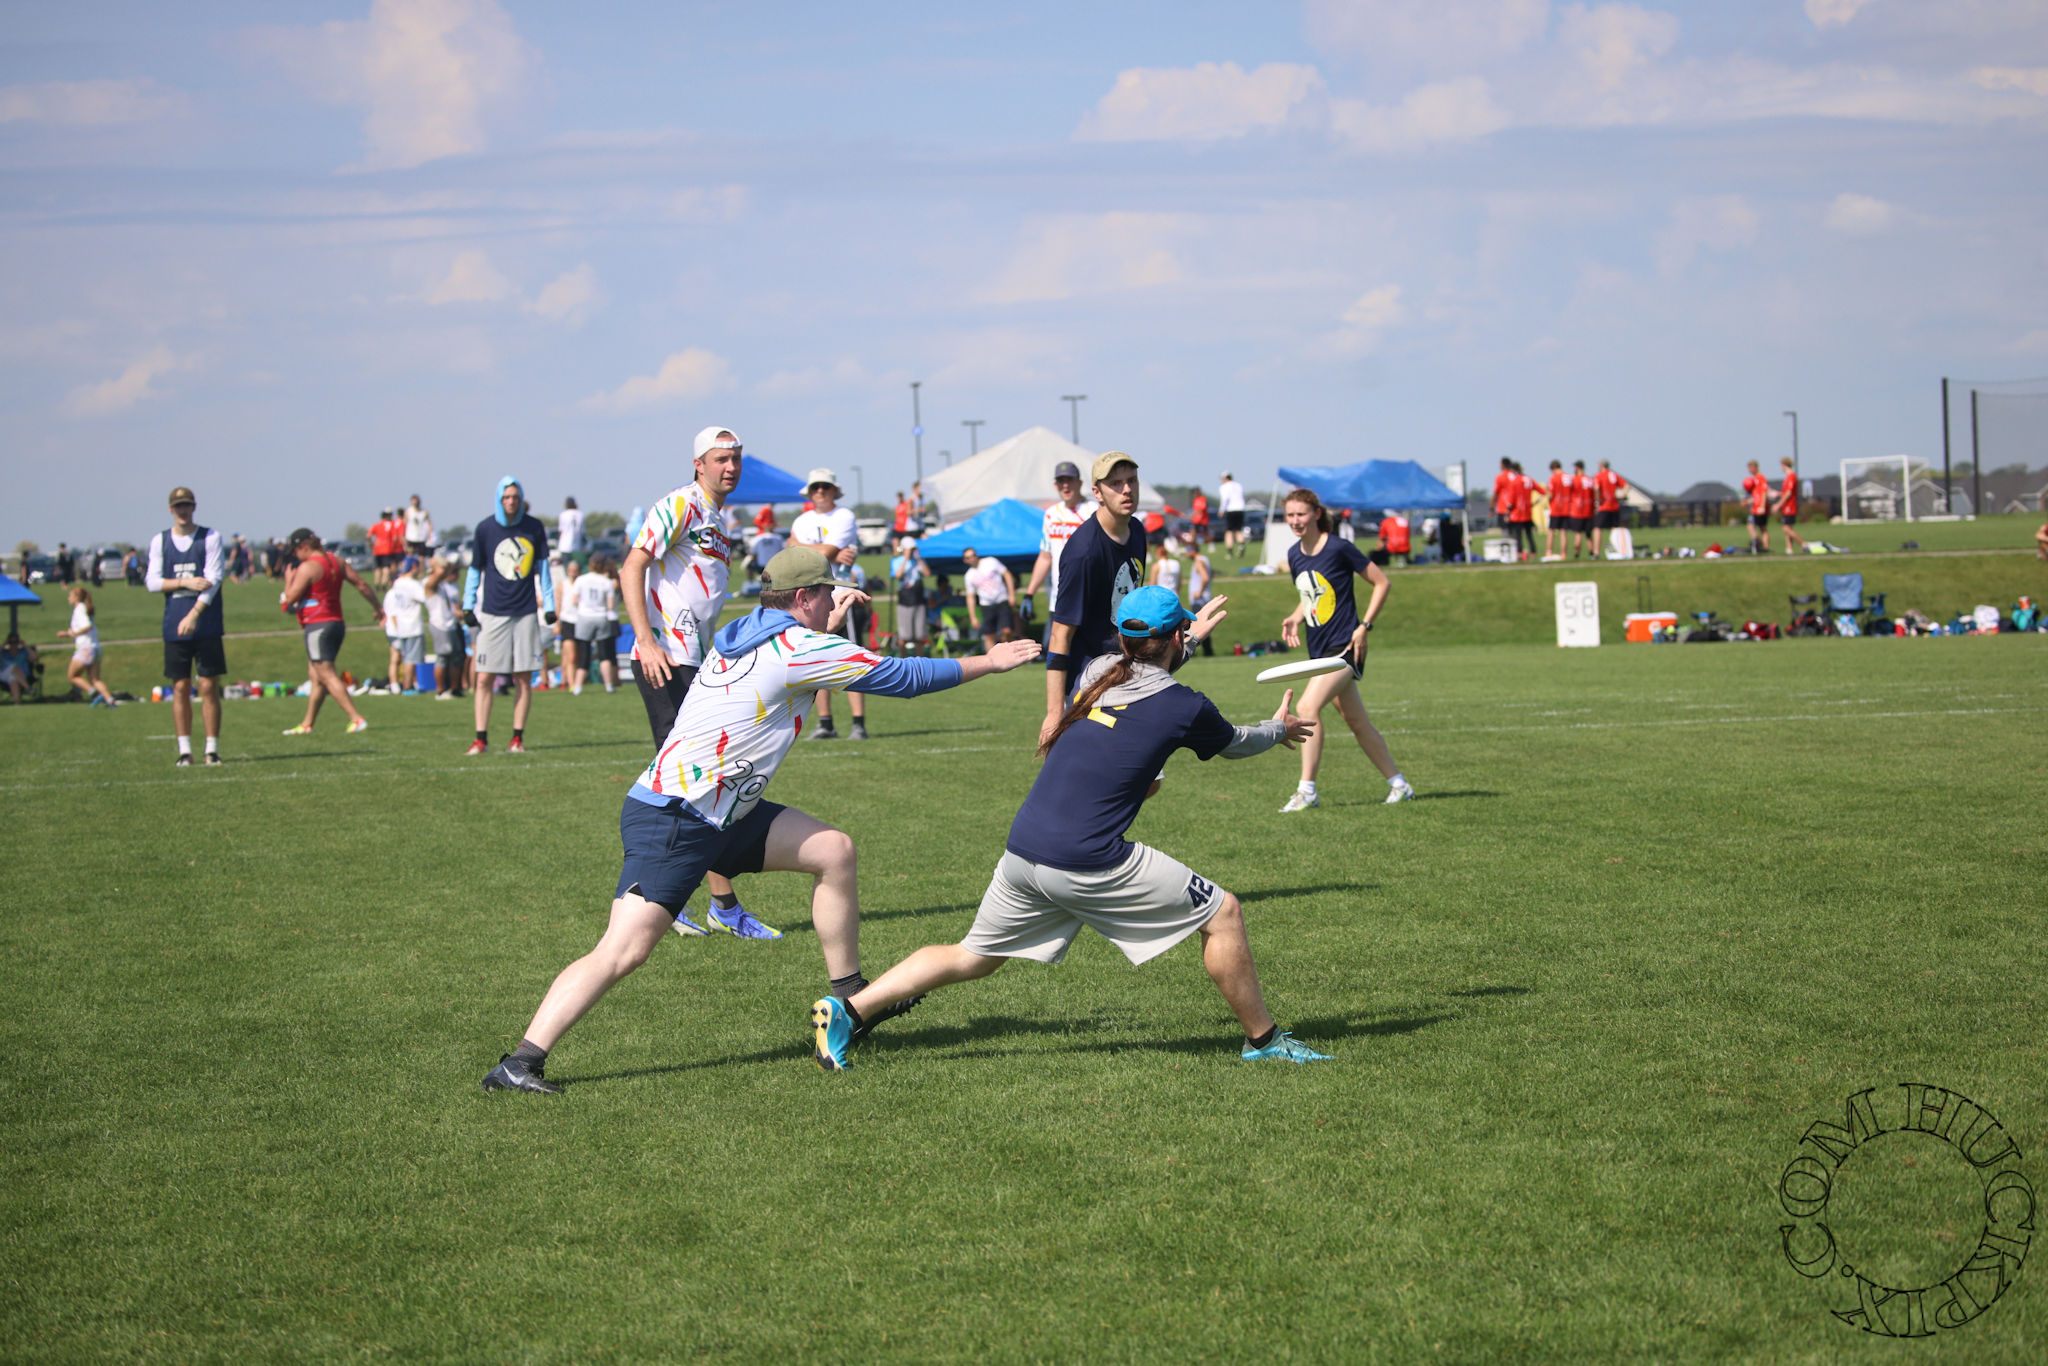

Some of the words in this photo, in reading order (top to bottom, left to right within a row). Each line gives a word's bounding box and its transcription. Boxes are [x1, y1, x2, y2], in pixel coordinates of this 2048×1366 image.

[1563, 595, 1595, 619] 58
[720, 759, 769, 803] 20
[1187, 873, 1214, 908] 42
